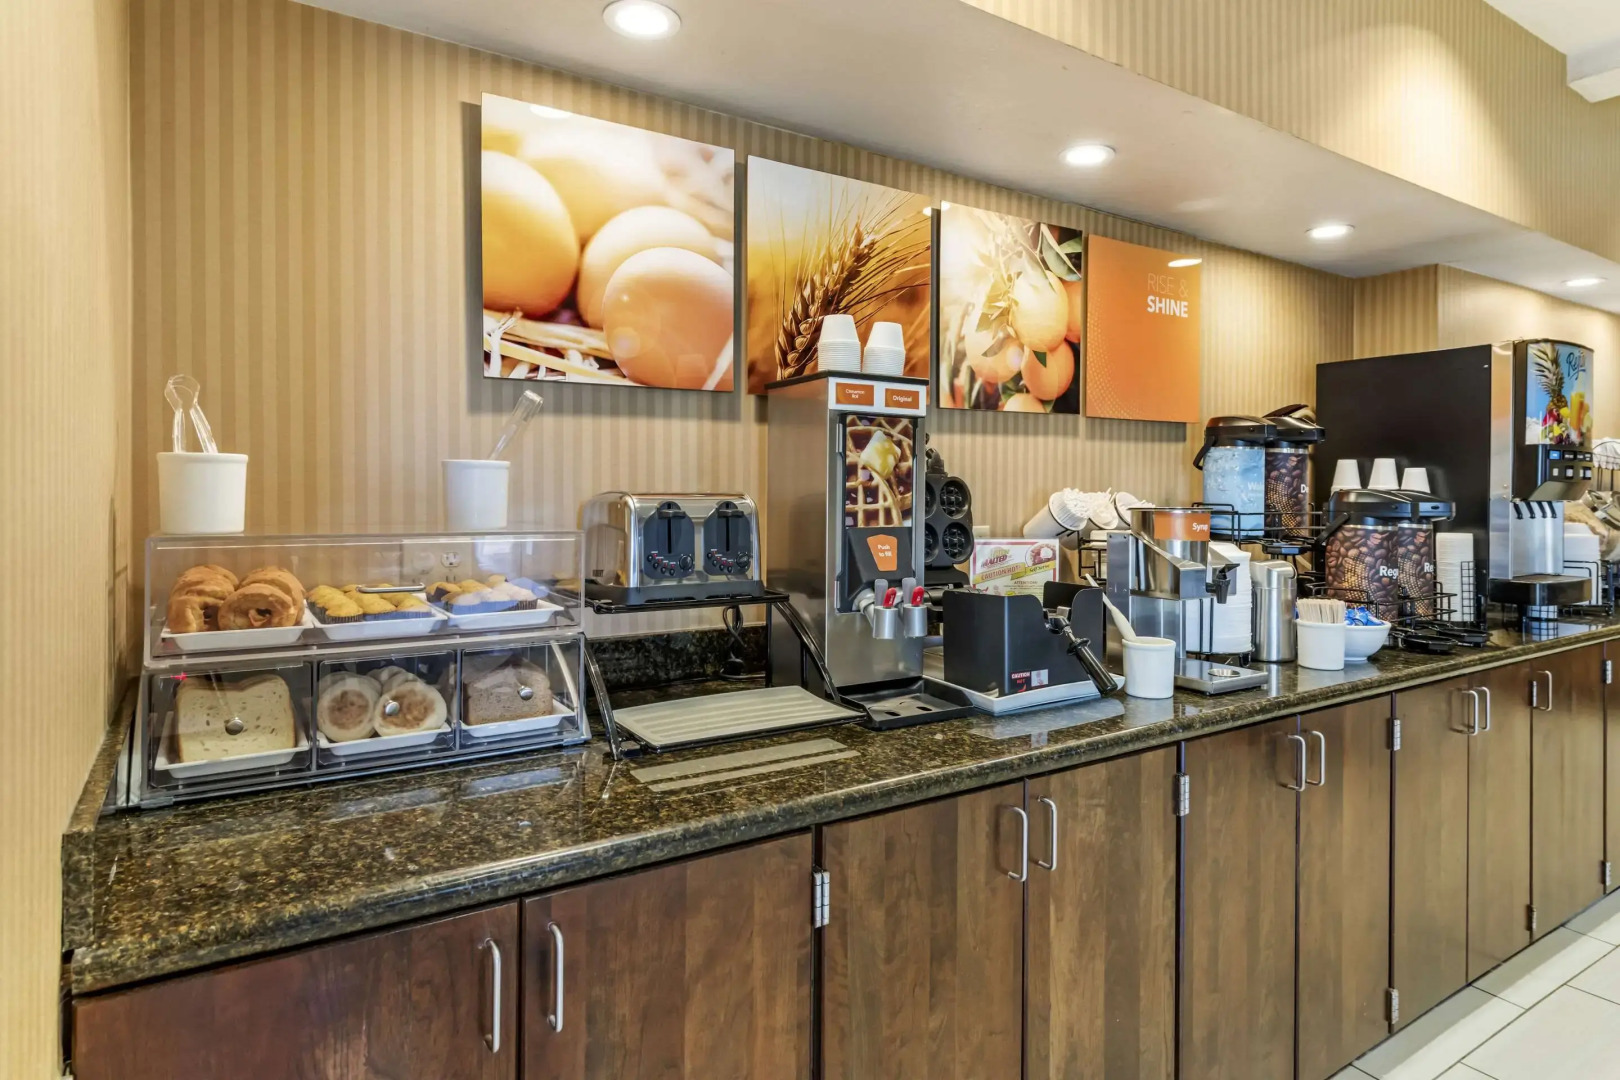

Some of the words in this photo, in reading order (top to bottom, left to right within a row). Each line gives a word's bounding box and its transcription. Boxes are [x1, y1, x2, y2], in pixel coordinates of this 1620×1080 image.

[1147, 273, 1174, 295] RISE
[1178, 279, 1189, 297] &
[1147, 295, 1188, 318] SHINE
[892, 395, 913, 403] Original
[1192, 522, 1208, 532] Syrup
